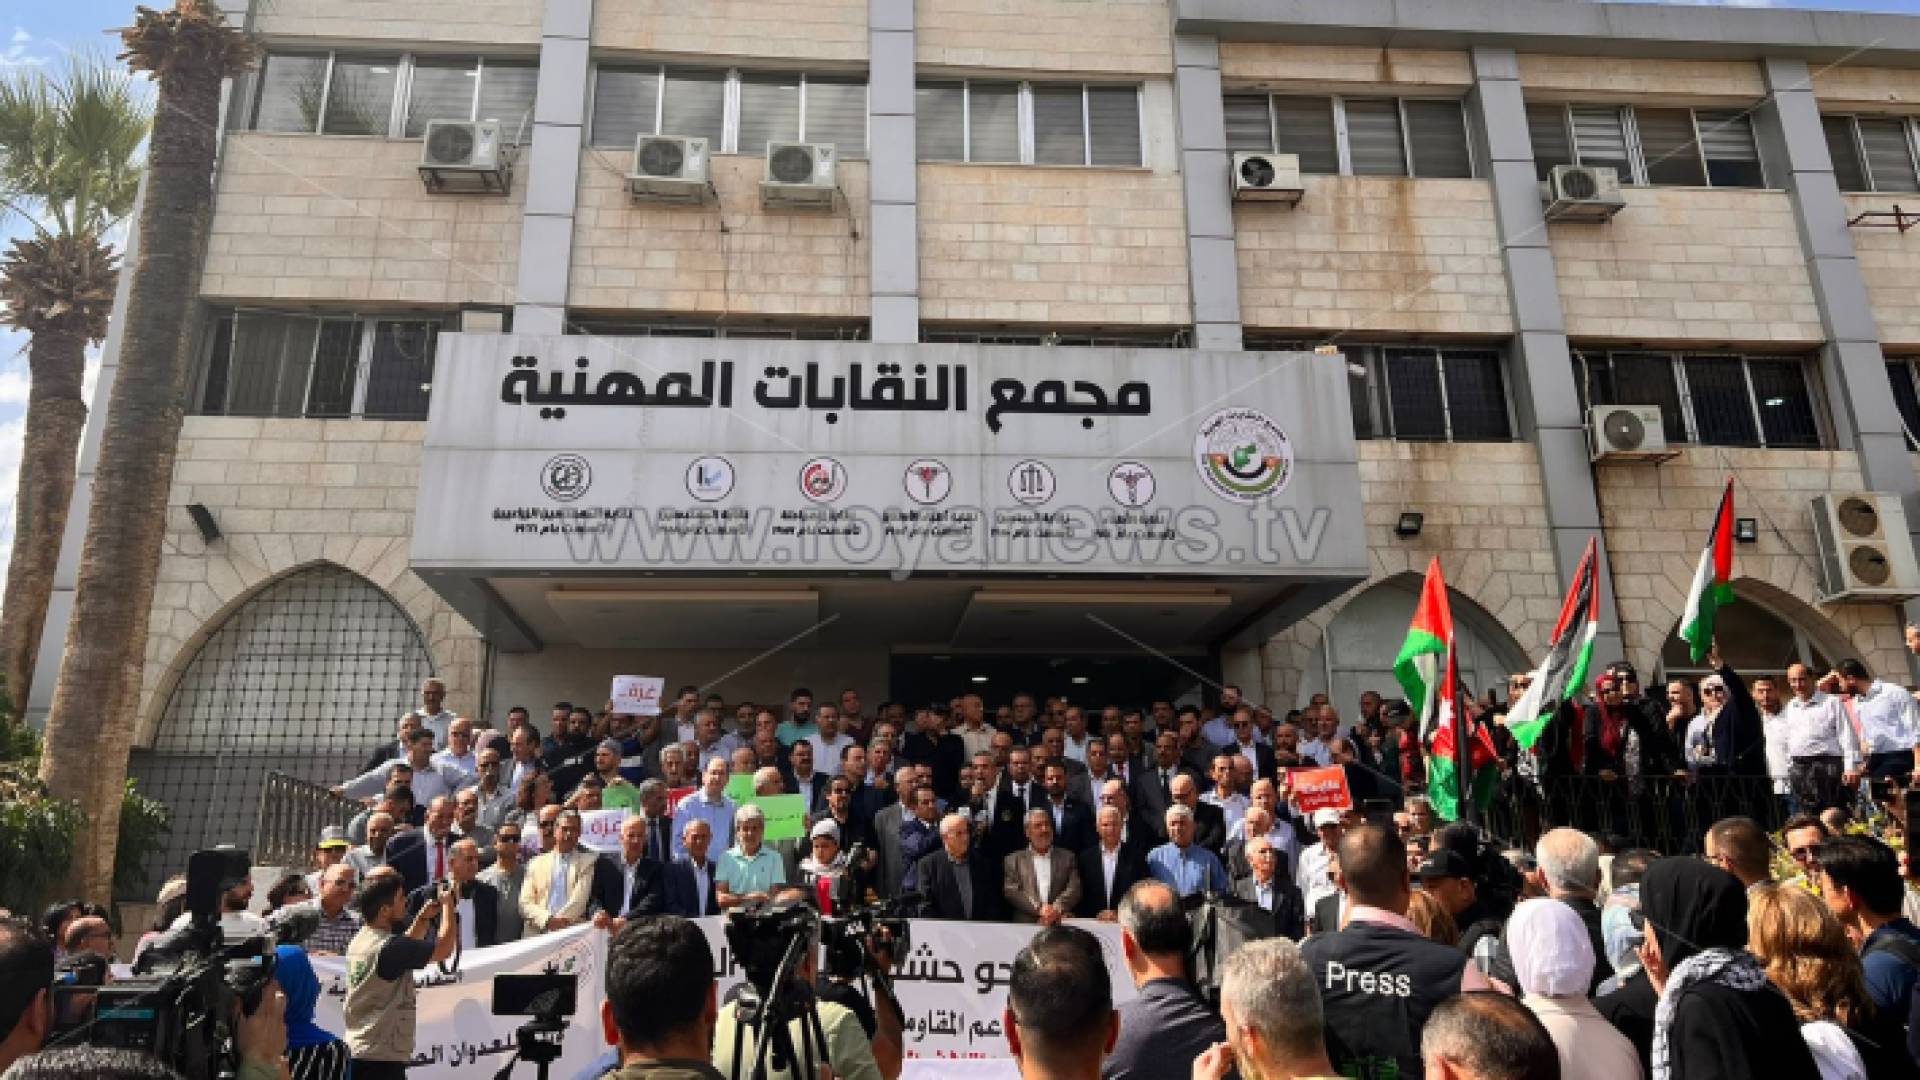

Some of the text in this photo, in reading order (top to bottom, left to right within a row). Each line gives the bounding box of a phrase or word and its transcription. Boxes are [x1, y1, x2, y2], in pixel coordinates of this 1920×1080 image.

[501, 355, 733, 420] المهنية
[755, 363, 967, 424] النقابات
[986, 380, 1151, 434] مجمع
[1325, 960, 1411, 997] Press
